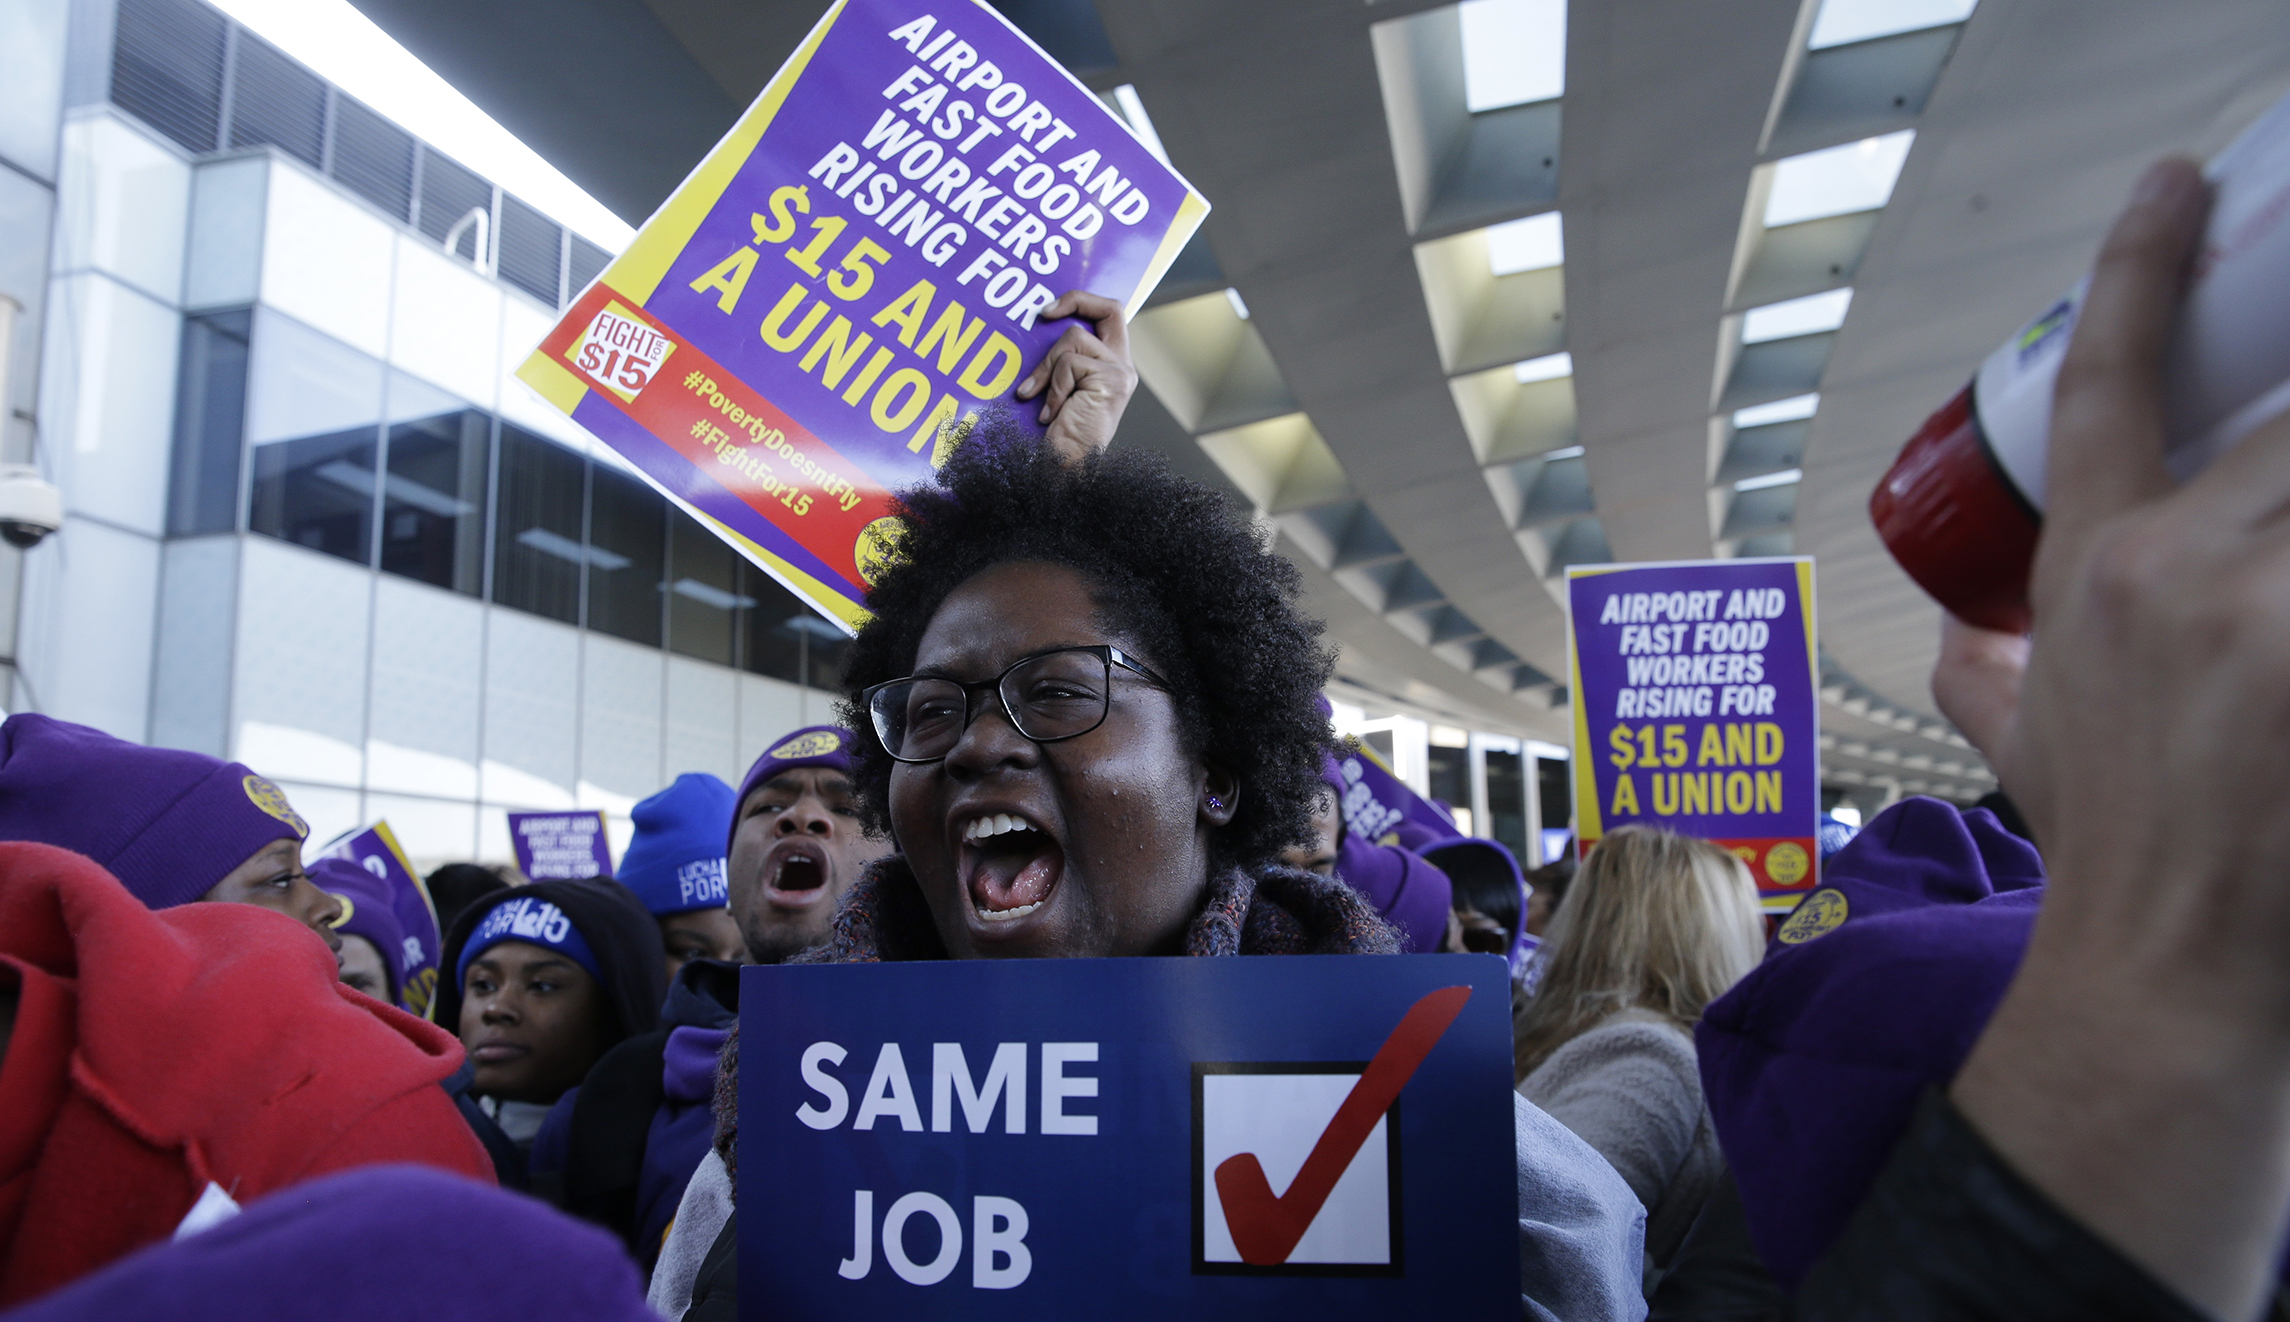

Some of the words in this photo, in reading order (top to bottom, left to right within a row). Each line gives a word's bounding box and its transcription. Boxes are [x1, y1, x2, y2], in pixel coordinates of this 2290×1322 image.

[882, 64, 1004, 155] FAST
[986, 142, 1104, 242] FOOD
[888, 14, 1077, 154] AIRPORT
[1057, 148, 1150, 226] AND
[808, 141, 967, 268] RISING
[956, 247, 1057, 332] FOR
[861, 108, 1071, 275] WORKERS
[593, 313, 668, 358] FIGHT
[650, 340, 665, 361] FOR
[750, 184, 893, 302] $15
[871, 278, 1023, 401] AND
[578, 340, 652, 391] $15
[689, 245, 761, 315] A
[759, 282, 980, 472] UNION
[682, 369, 862, 512] #PovertyDoesntFly
[689, 418, 815, 517] #FightFor15
[1600, 589, 1722, 625] AIRPORT
[1723, 587, 1786, 619] AND
[1619, 623, 1690, 655] FAST
[1693, 620, 1770, 653] FOOD
[1616, 686, 1713, 719] RISING
[1719, 684, 1777, 716] FOR
[1627, 652, 1765, 687] WORKERS
[1609, 722, 1688, 771] $15
[1697, 723, 1784, 767] AND
[1612, 774, 1639, 815] A
[1652, 770, 1782, 816] UNION
[680, 875, 725, 905] POR
[795, 1041, 1099, 1136] SAME
[838, 1189, 1033, 1290] JOB
